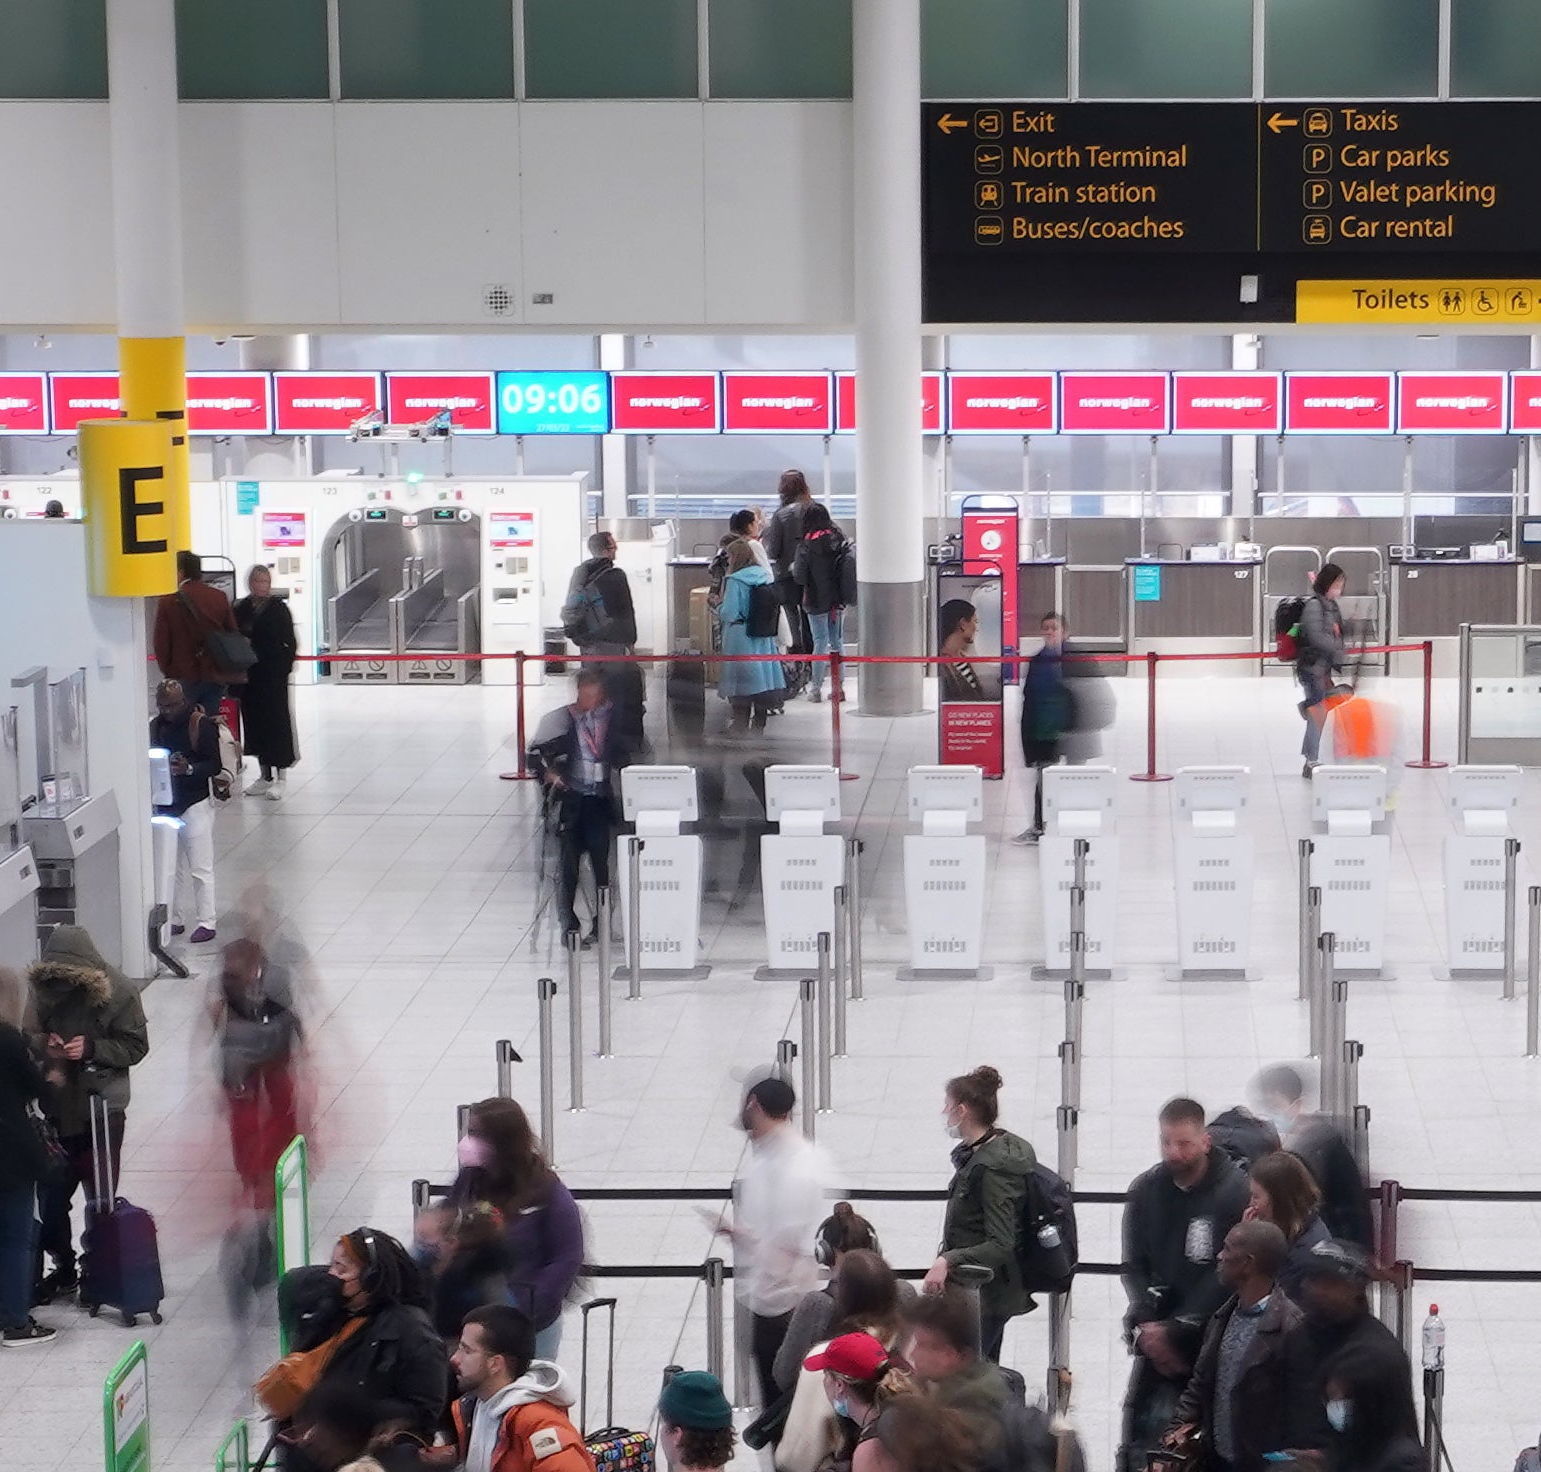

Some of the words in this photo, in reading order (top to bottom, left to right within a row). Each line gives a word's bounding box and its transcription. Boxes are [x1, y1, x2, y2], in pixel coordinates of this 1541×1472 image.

[1012, 111, 1055, 132] Exit
[1340, 109, 1399, 132] Taxis
[1012, 145, 1080, 168] North
[1086, 145, 1187, 167] Terminal
[1340, 145, 1379, 167] Car
[1386, 145, 1450, 172] parks
[1011, 181, 1069, 203] Train
[1076, 182, 1156, 203] station
[1340, 181, 1400, 203] Valet
[1406, 180, 1496, 208] parking
[1012, 217, 1184, 240] Buses/coaches
[1340, 216, 1379, 238] Car
[1386, 216, 1453, 238] rental
[1352, 290, 1429, 310] Toilets
[68, 397, 120, 410] norweg
[292, 397, 362, 410] norwegian
[405, 397, 477, 410] norwegian
[502, 384, 601, 414] 09:06
[630, 396, 700, 409] norwegian
[742, 396, 813, 409] norwegian
[966, 396, 1038, 410] norwegian
[1079, 397, 1150, 410] norwegian
[1191, 397, 1263, 410] norwegian
[1304, 397, 1375, 410] norwegian
[1416, 396, 1488, 409] norwegian
[37, 486, 52, 494] 122
[119, 466, 167, 555] E
